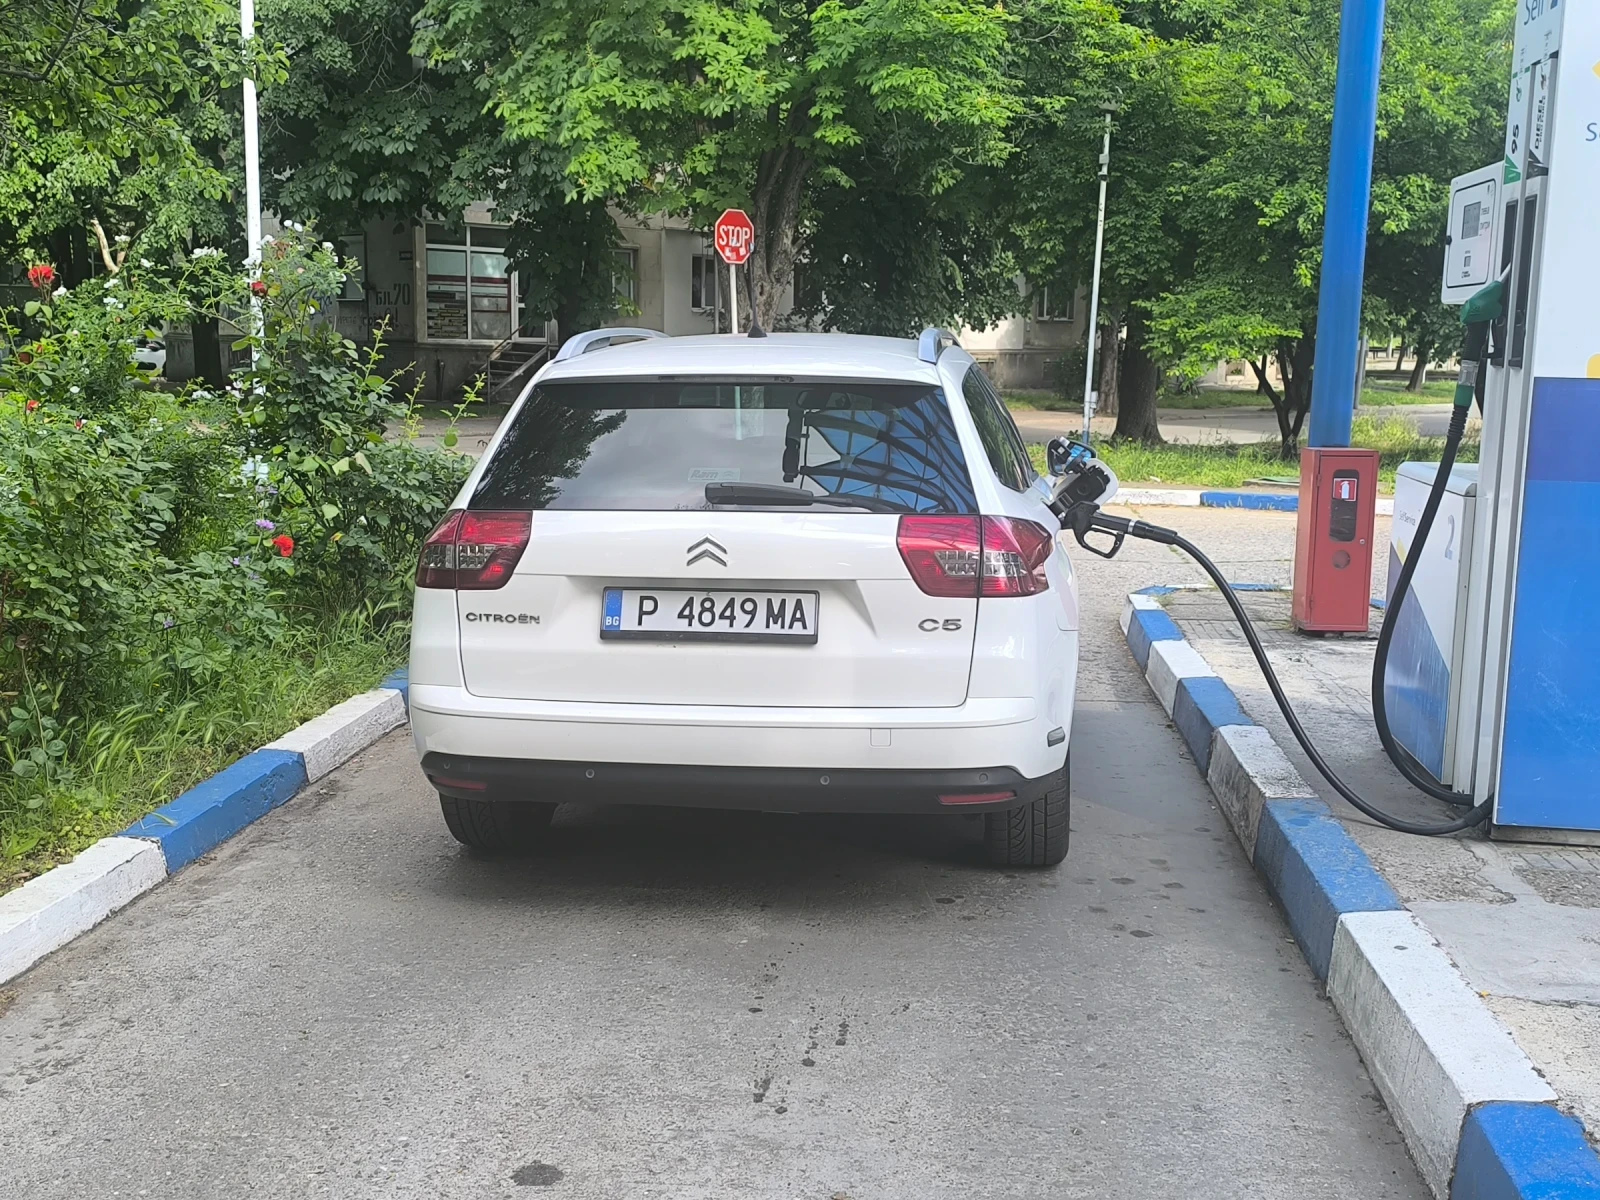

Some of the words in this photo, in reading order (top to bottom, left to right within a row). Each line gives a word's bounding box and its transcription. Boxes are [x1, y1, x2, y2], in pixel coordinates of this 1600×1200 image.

[1535, 99, 1543, 150] DIESEL
[1585, 122, 1600, 142] S
[1511, 124, 1520, 154] 95
[719, 224, 750, 248] STOP
[465, 612, 541, 624] CITROËN
[605, 616, 620, 626] BG
[637, 595, 658, 626] P
[677, 596, 758, 628] 4849
[765, 598, 808, 630] MA
[918, 618, 962, 632] C5
